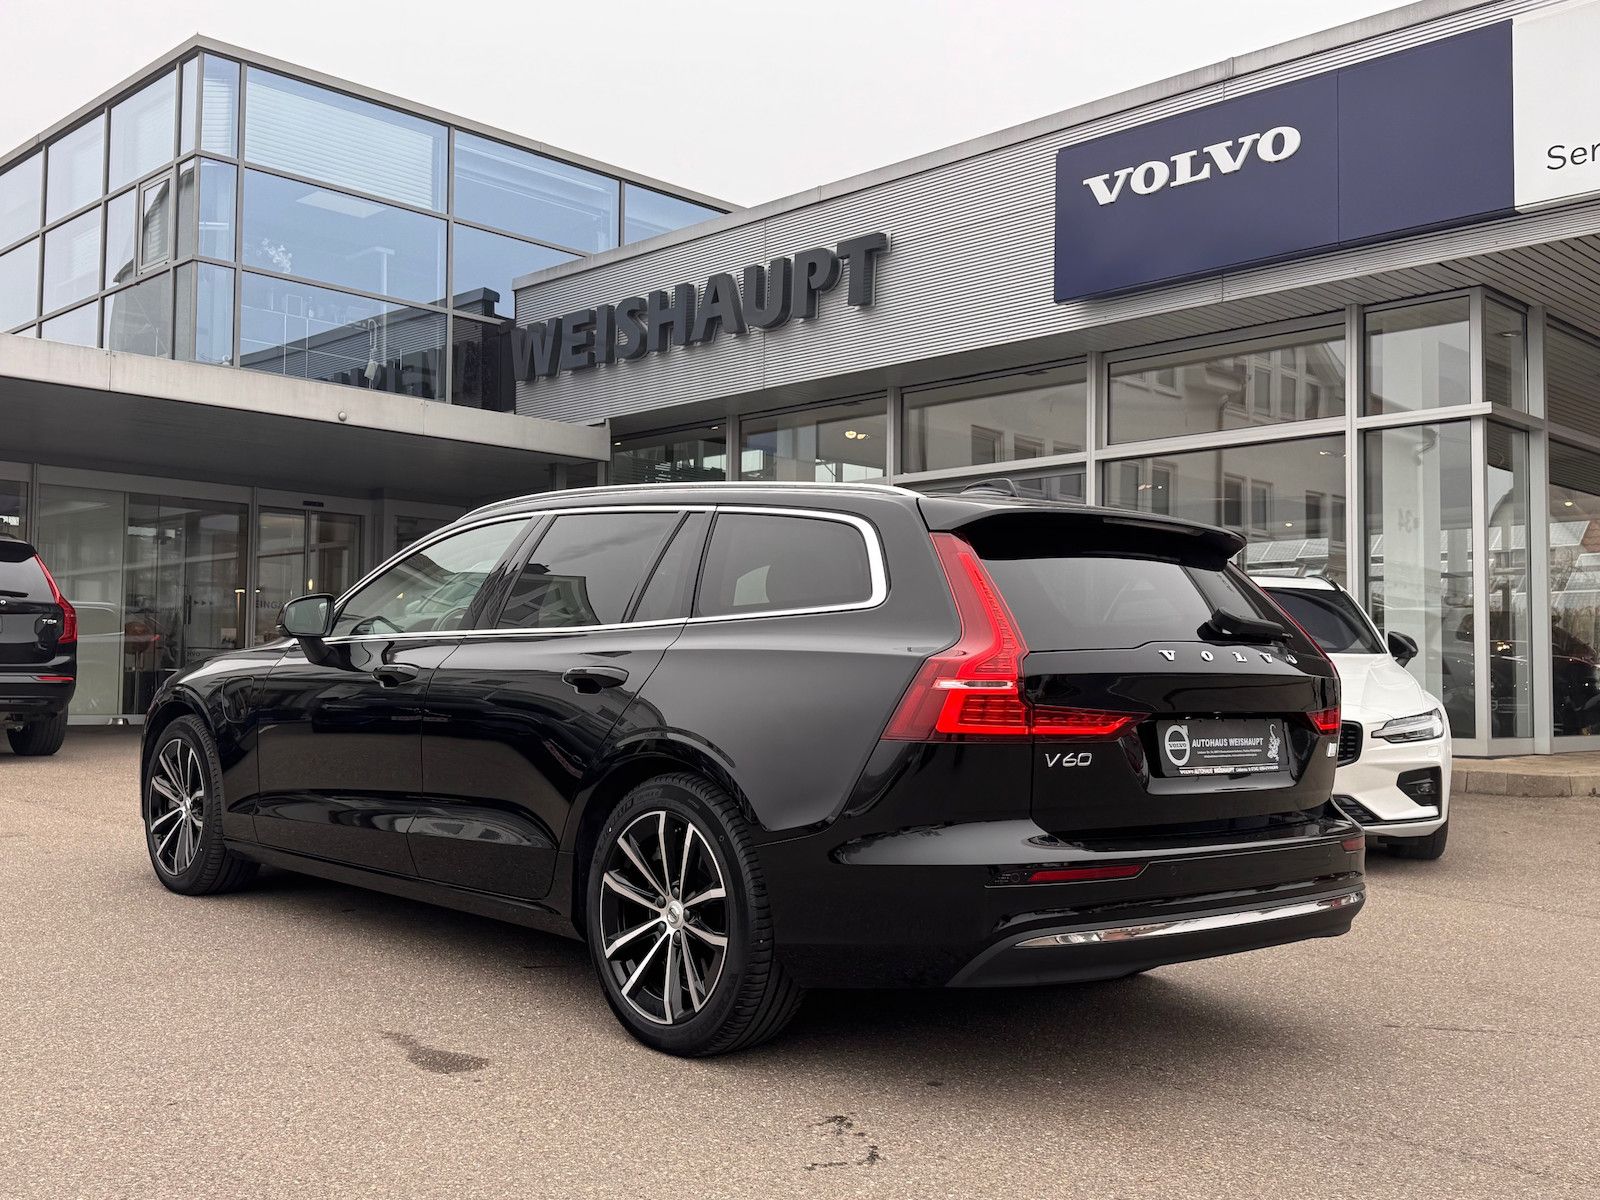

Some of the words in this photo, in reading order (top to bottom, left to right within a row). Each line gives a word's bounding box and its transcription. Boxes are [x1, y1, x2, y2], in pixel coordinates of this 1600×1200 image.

[1546, 143, 1600, 170] Ser
[1082, 125, 1301, 206] VOLVO
[511, 232, 890, 382] WEISHAUPT
[1158, 649, 1298, 665] VOLVO
[1168, 740, 1187, 748] VOLVO
[1191, 738, 1228, 748] AUTOHAUS
[1228, 737, 1264, 747] WEISHAUPT
[1045, 752, 1093, 768] V60
